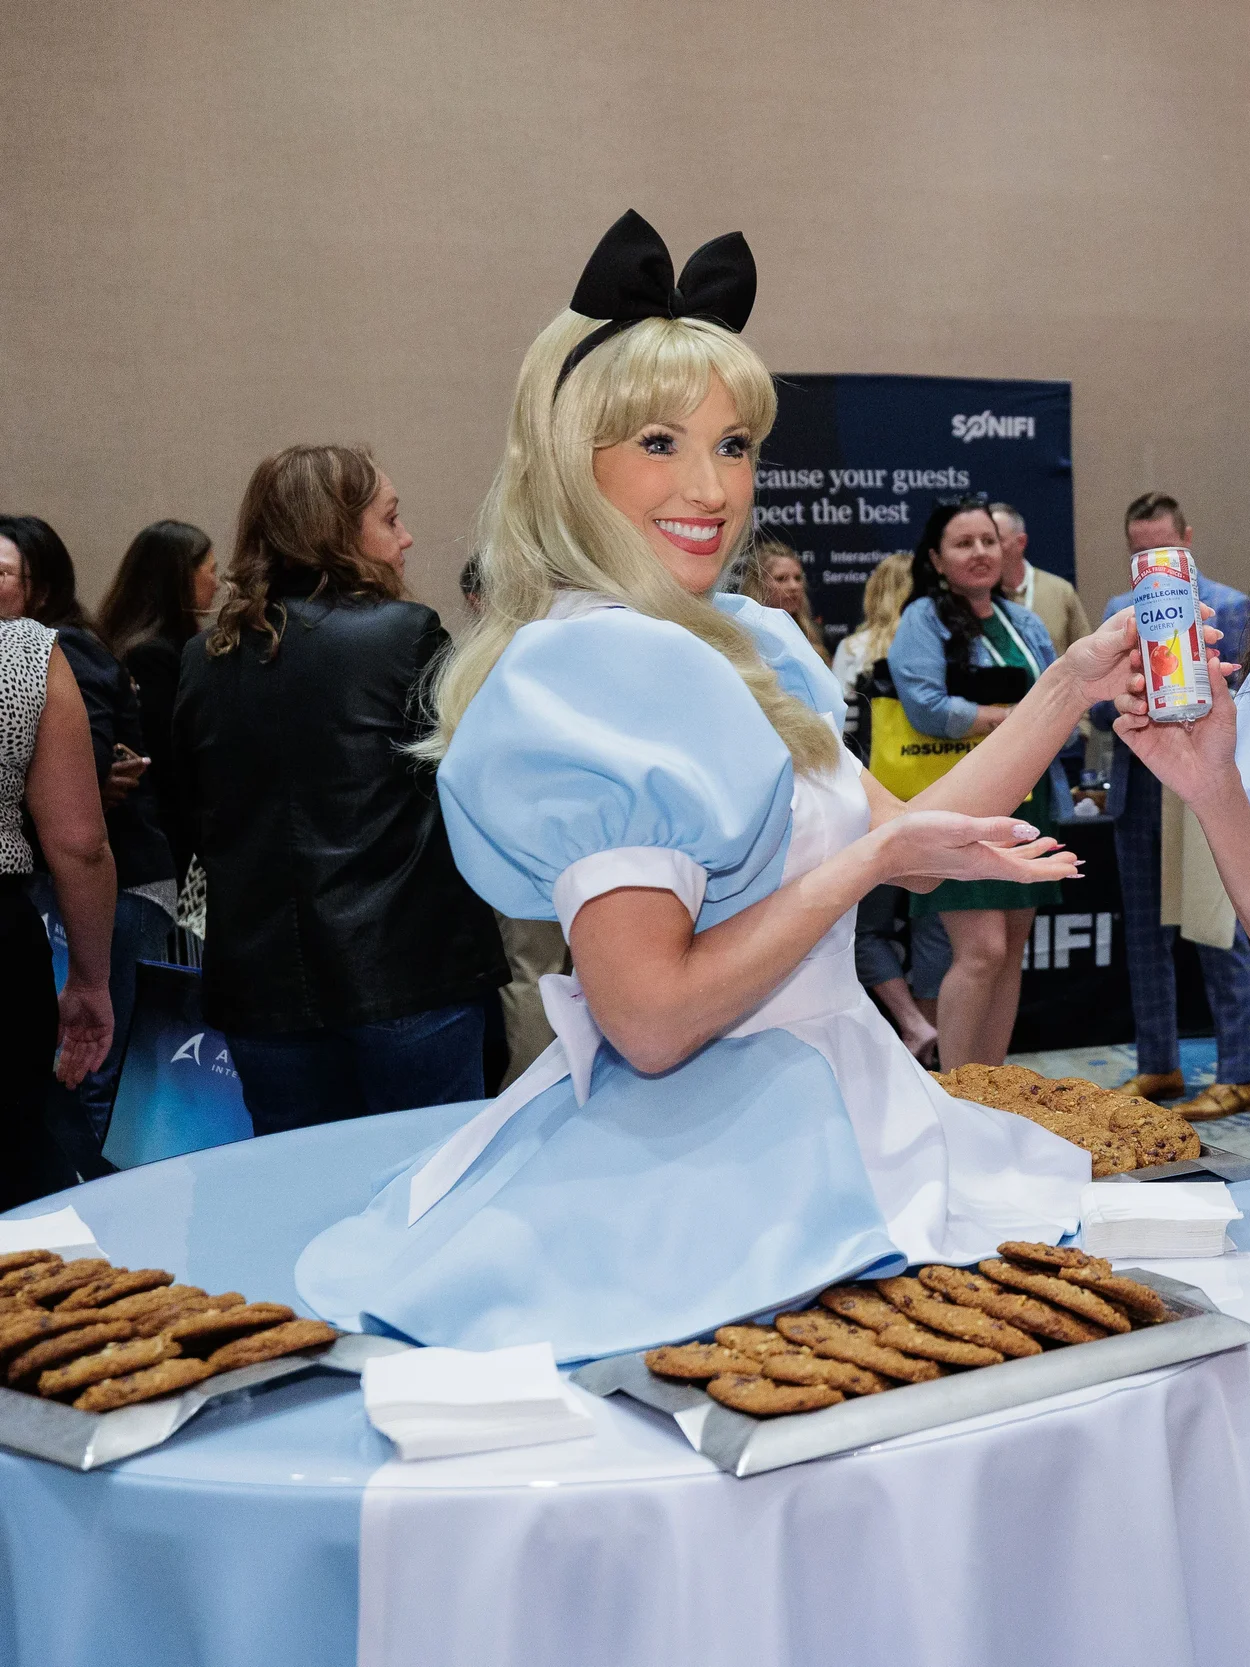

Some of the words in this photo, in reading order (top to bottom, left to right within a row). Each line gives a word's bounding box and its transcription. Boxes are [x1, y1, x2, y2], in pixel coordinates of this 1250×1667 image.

[754, 468, 824, 489] cause
[829, 469, 888, 495] your
[892, 466, 971, 495] guests
[753, 501, 806, 531] pect
[812, 498, 853, 525] the
[858, 497, 910, 525] best
[823, 570, 867, 584] Service
[1141, 568, 1152, 577] REAL
[1140, 606, 1184, 625] CIAO!
[1149, 621, 1175, 632] CHERRY
[1022, 912, 1112, 969] IFI
